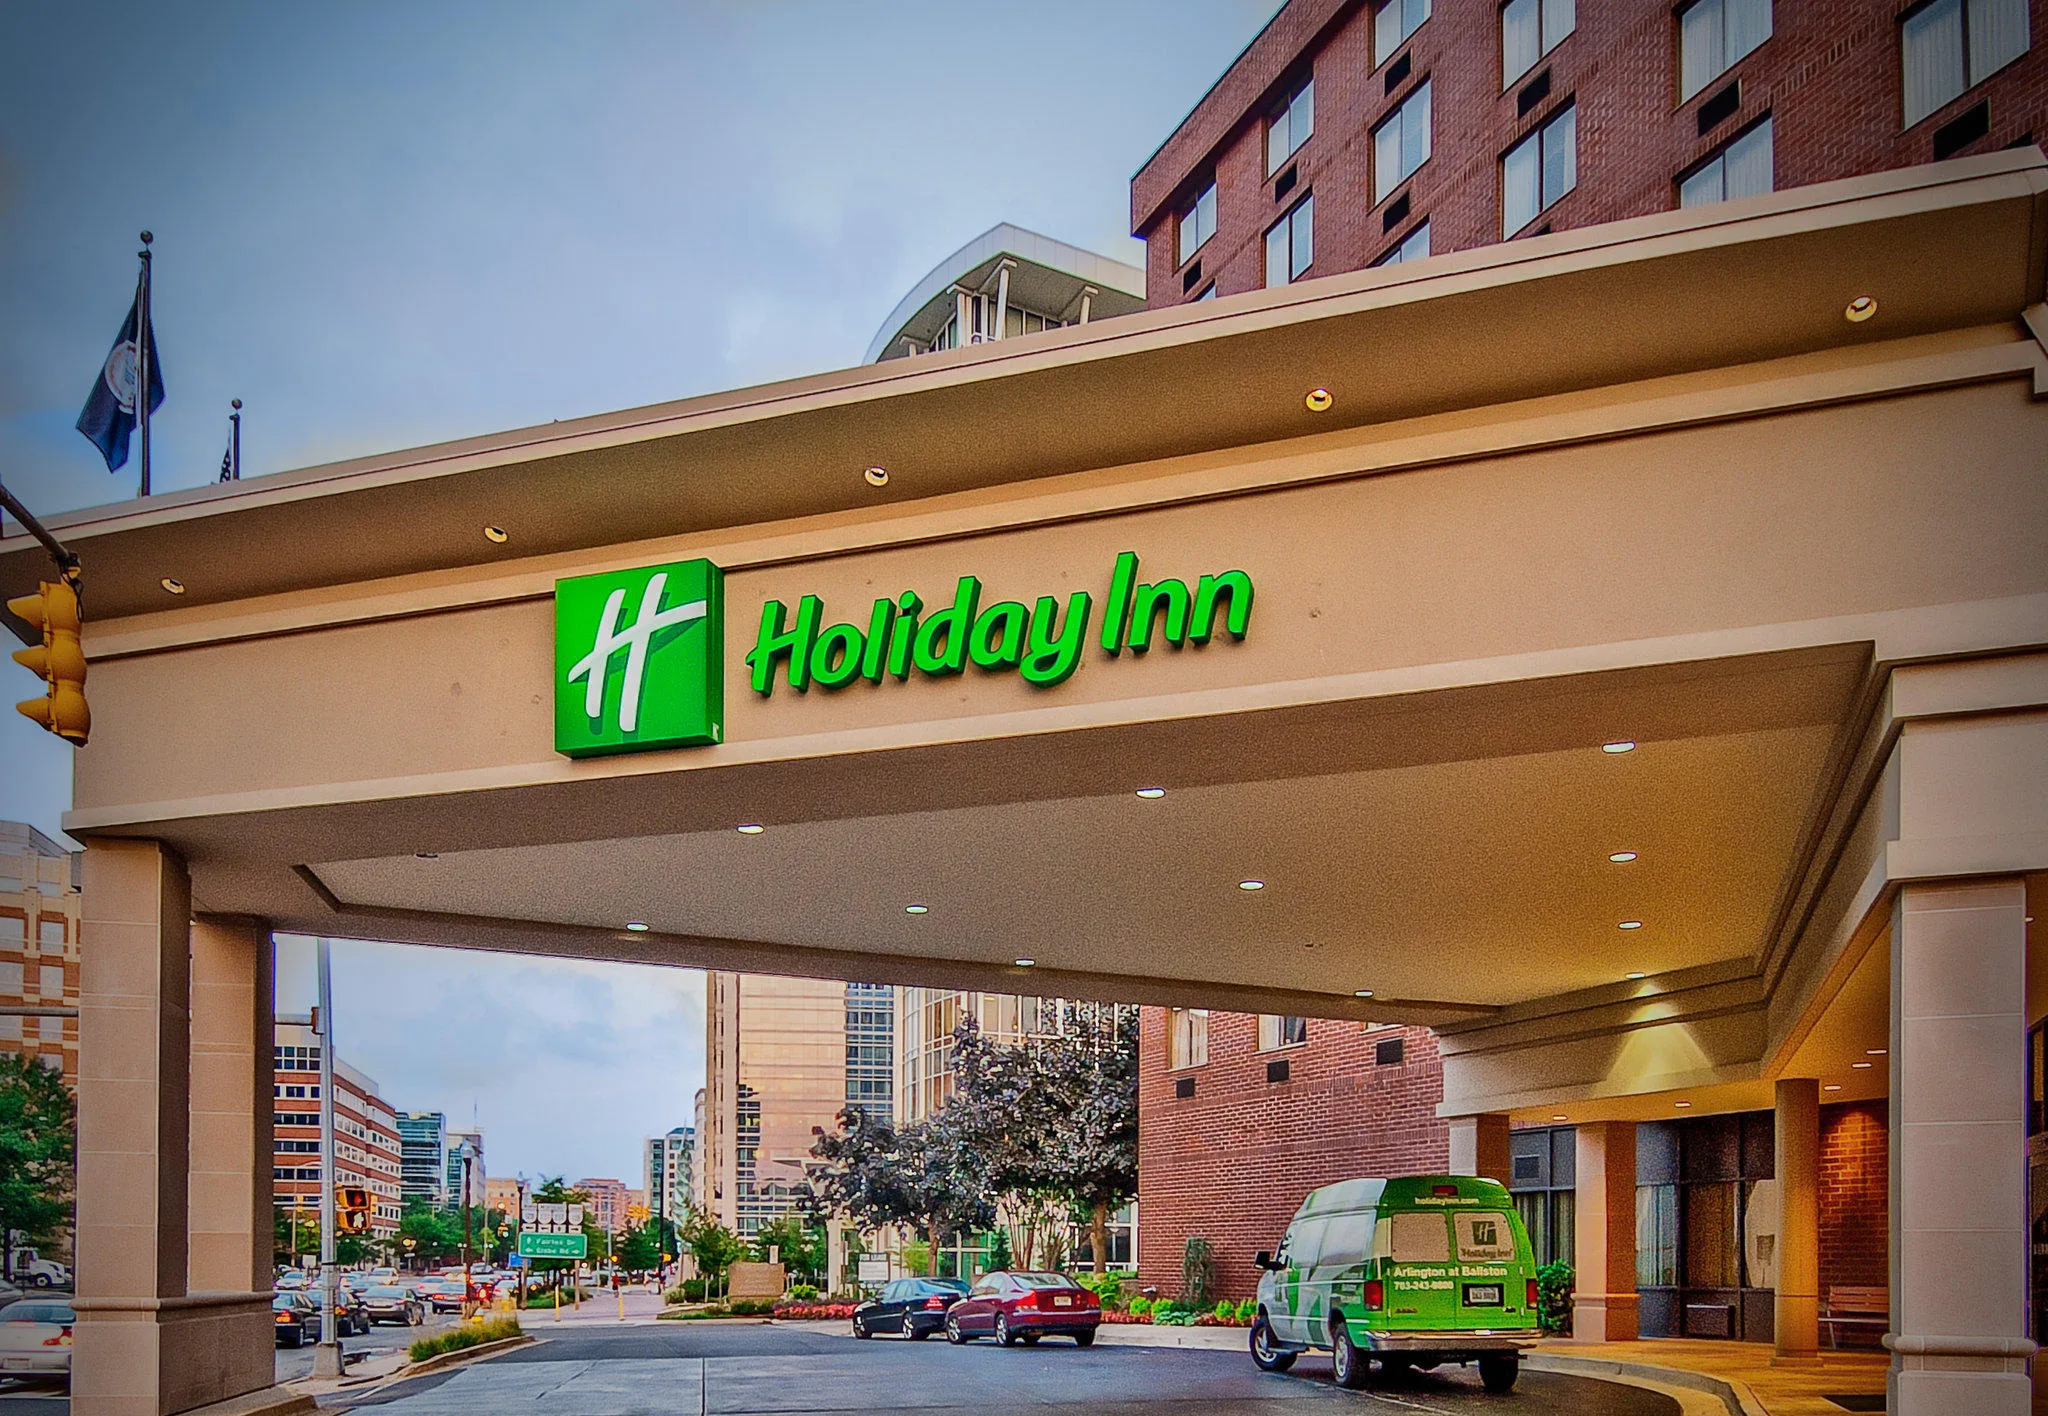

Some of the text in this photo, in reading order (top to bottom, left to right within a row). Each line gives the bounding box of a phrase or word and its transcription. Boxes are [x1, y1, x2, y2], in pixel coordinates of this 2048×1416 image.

[746, 552, 1255, 697] Holiday Inn
[1461, 1248, 1511, 1258] Holiday Inn
[1394, 1266, 1508, 1279] Arlington at Ballston
